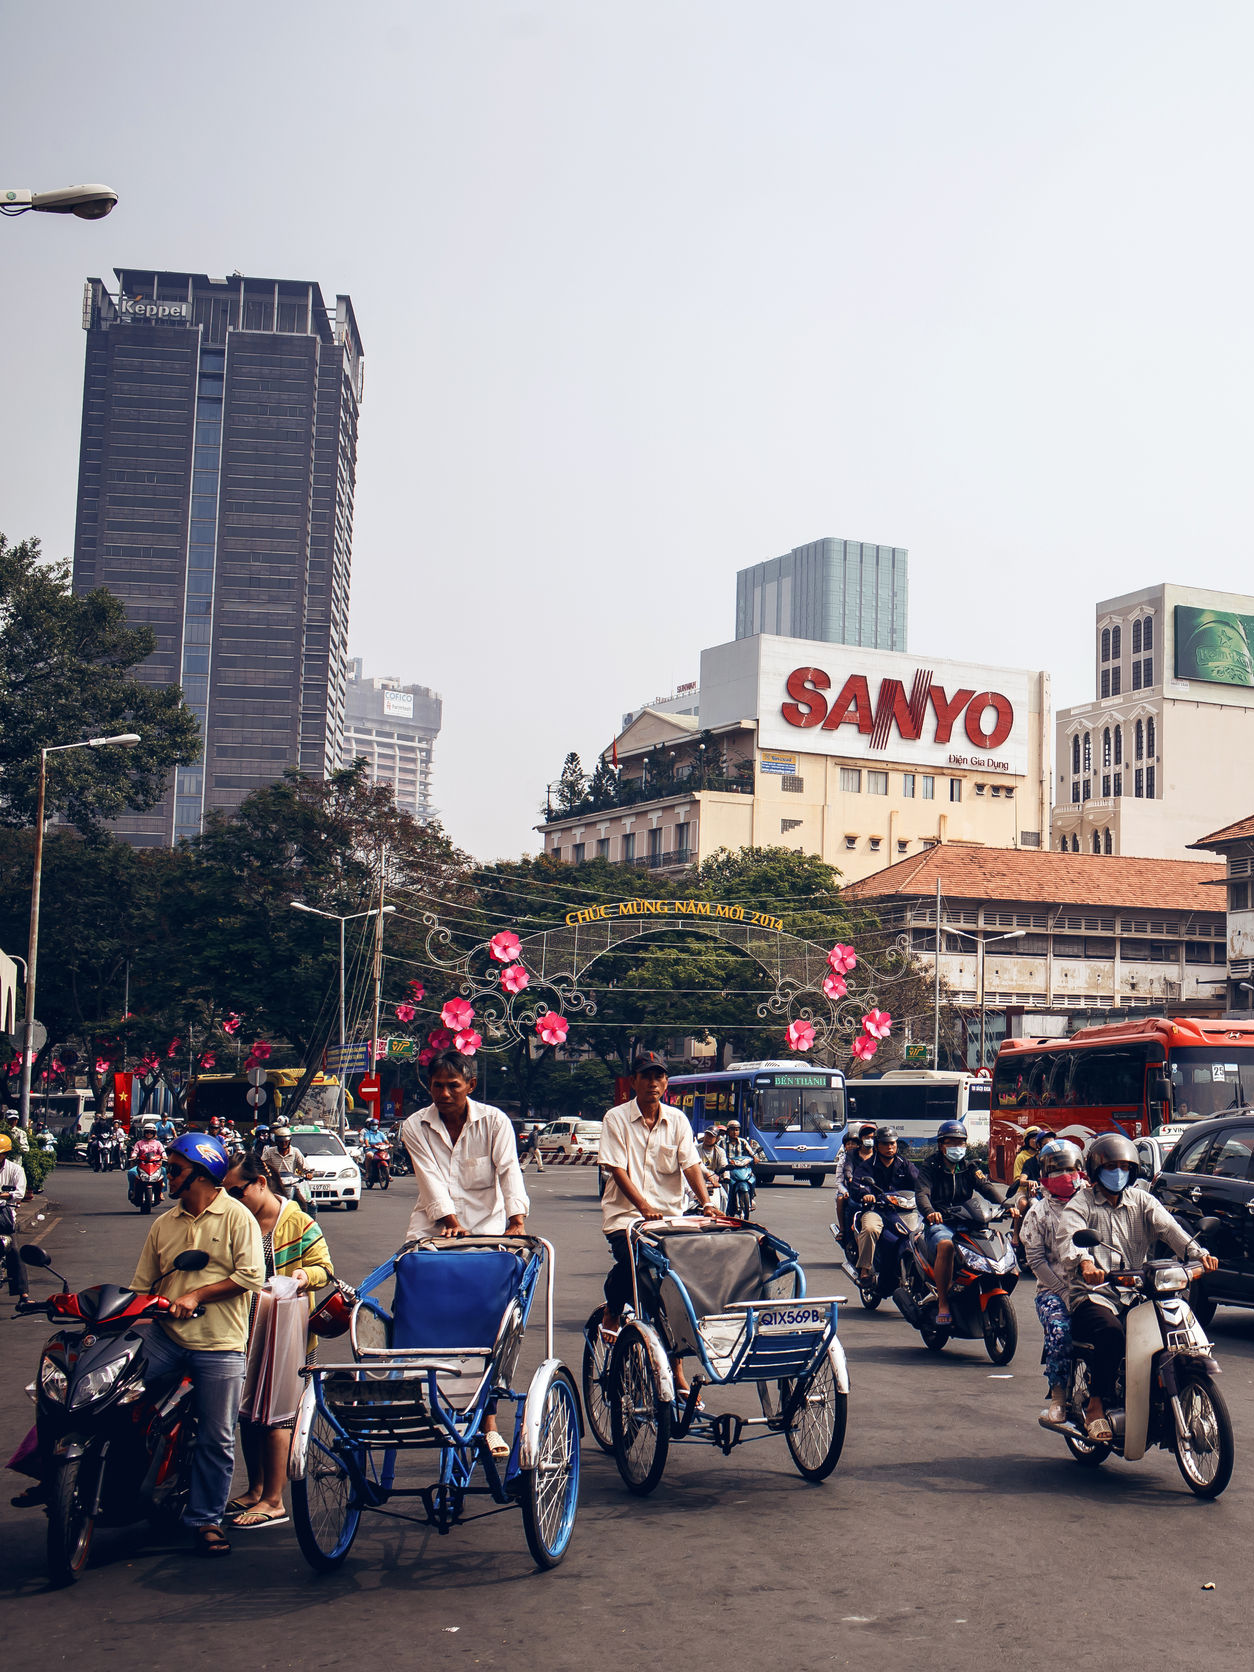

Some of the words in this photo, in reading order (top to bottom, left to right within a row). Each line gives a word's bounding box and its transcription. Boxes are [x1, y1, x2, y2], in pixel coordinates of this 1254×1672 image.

[121, 299, 187, 318] Keppel
[385, 691, 413, 703] COFICO
[781, 666, 1014, 751] SANYO
[948, 753, 969, 768] Điện
[970, 756, 986, 768] Gia
[987, 757, 1009, 771] Dụng
[565, 904, 612, 927] CHÚC
[618, 898, 668, 916] MỪNG
[674, 899, 711, 916] NĂM
[715, 904, 746, 921] MỚI
[750, 911, 784, 931] 2014
[774, 1074, 794, 1085] BẾN
[1213, 1066, 1224, 1076] 25
[760, 1309, 820, 1326] Q1X569B
